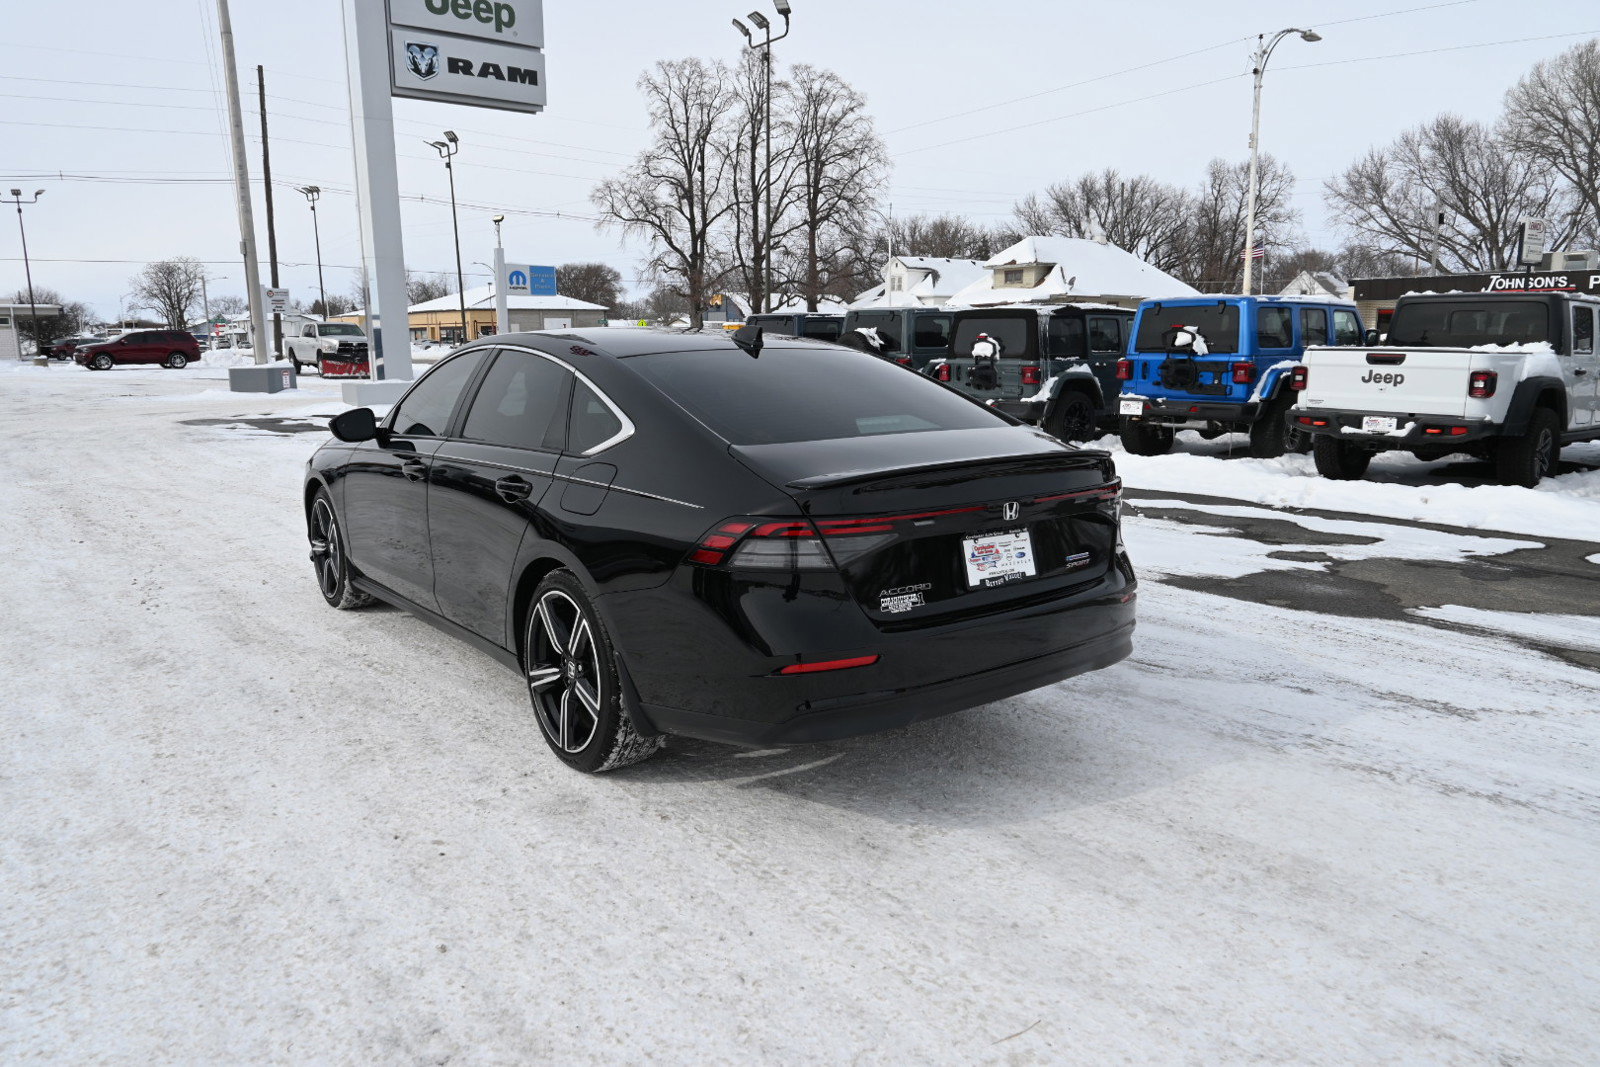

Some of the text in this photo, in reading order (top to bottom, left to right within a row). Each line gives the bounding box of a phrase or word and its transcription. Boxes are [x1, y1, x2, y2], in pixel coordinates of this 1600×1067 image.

[425, 0, 516, 33] Jeep
[447, 57, 538, 86] RAM
[1361, 369, 1405, 387] Jeep
[878, 582, 932, 598] ACCORD
